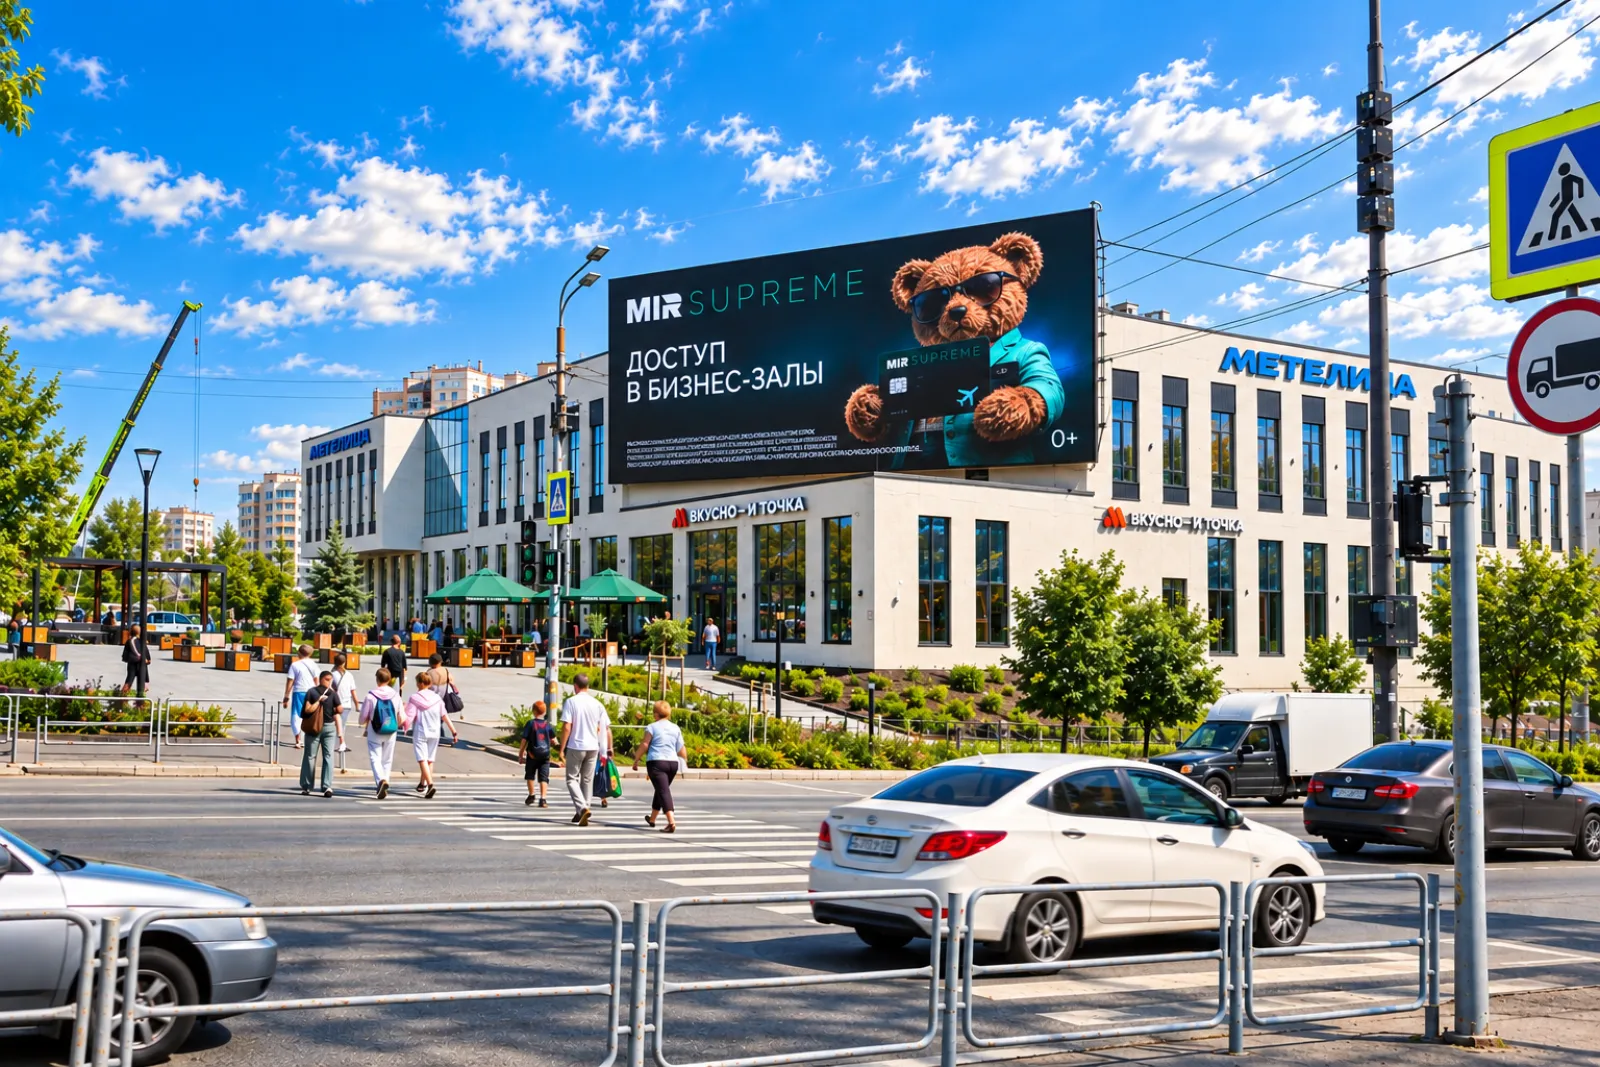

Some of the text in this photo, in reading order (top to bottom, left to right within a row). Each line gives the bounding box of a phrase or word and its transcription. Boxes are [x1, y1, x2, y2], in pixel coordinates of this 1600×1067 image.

[626, 269, 864, 324] MIR SUPREME
[626, 340, 726, 378] ДОСТУП
[886, 345, 981, 370] MIR SUPREME
[1220, 346, 1417, 398] МЕТЕЛИА
[626, 360, 823, 403] В БИЗНЕС-ЗАЛЫ
[1051, 429, 1079, 448] 0+
[747, 502, 757, 517] И
[760, 496, 805, 514] ТОЧКА
[1193, 517, 1204, 529] И
[1205, 518, 1245, 532] ТОЧКА
